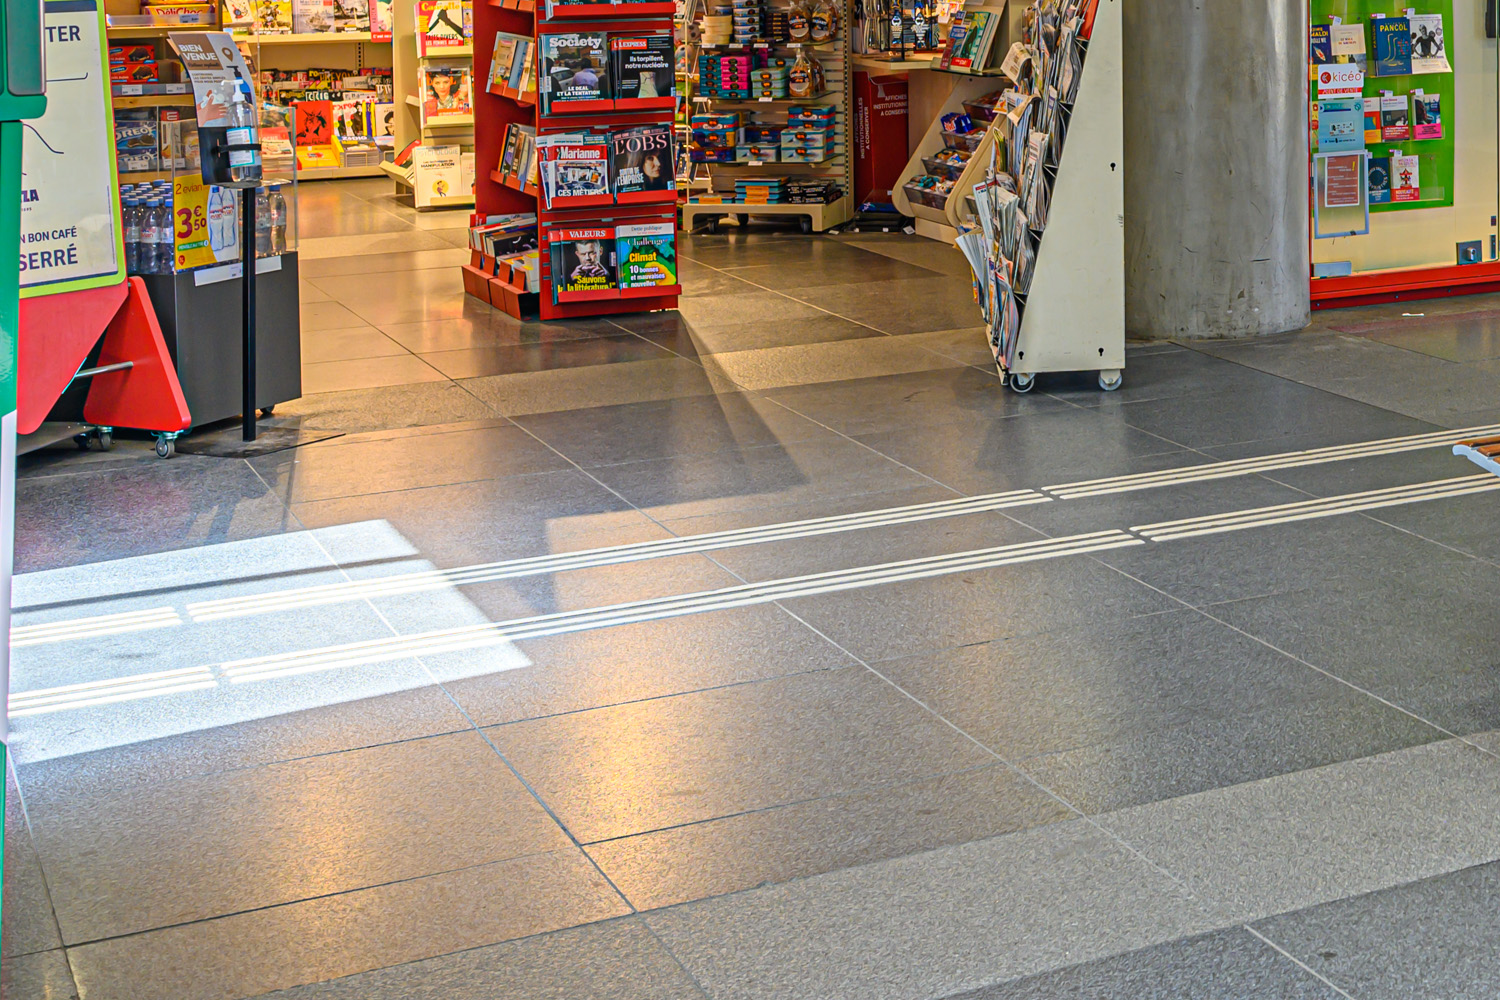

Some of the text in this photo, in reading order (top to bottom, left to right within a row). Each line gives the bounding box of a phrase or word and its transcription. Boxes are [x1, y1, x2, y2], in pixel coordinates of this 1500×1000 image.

[178, 44, 203, 52] BIEN
[549, 36, 602, 49] Society
[637, 55, 664, 63] torpillent
[1332, 70, 1361, 81] kicéo
[613, 134, 668, 155] L'OBS
[561, 146, 600, 159] Marianne
[175, 183, 203, 195] 2 evian
[177, 205, 207, 239] 3 € 50
[28, 225, 77, 243] BON CAFÉ
[629, 252, 656, 262] Climat
[629, 265, 638, 273] 10
